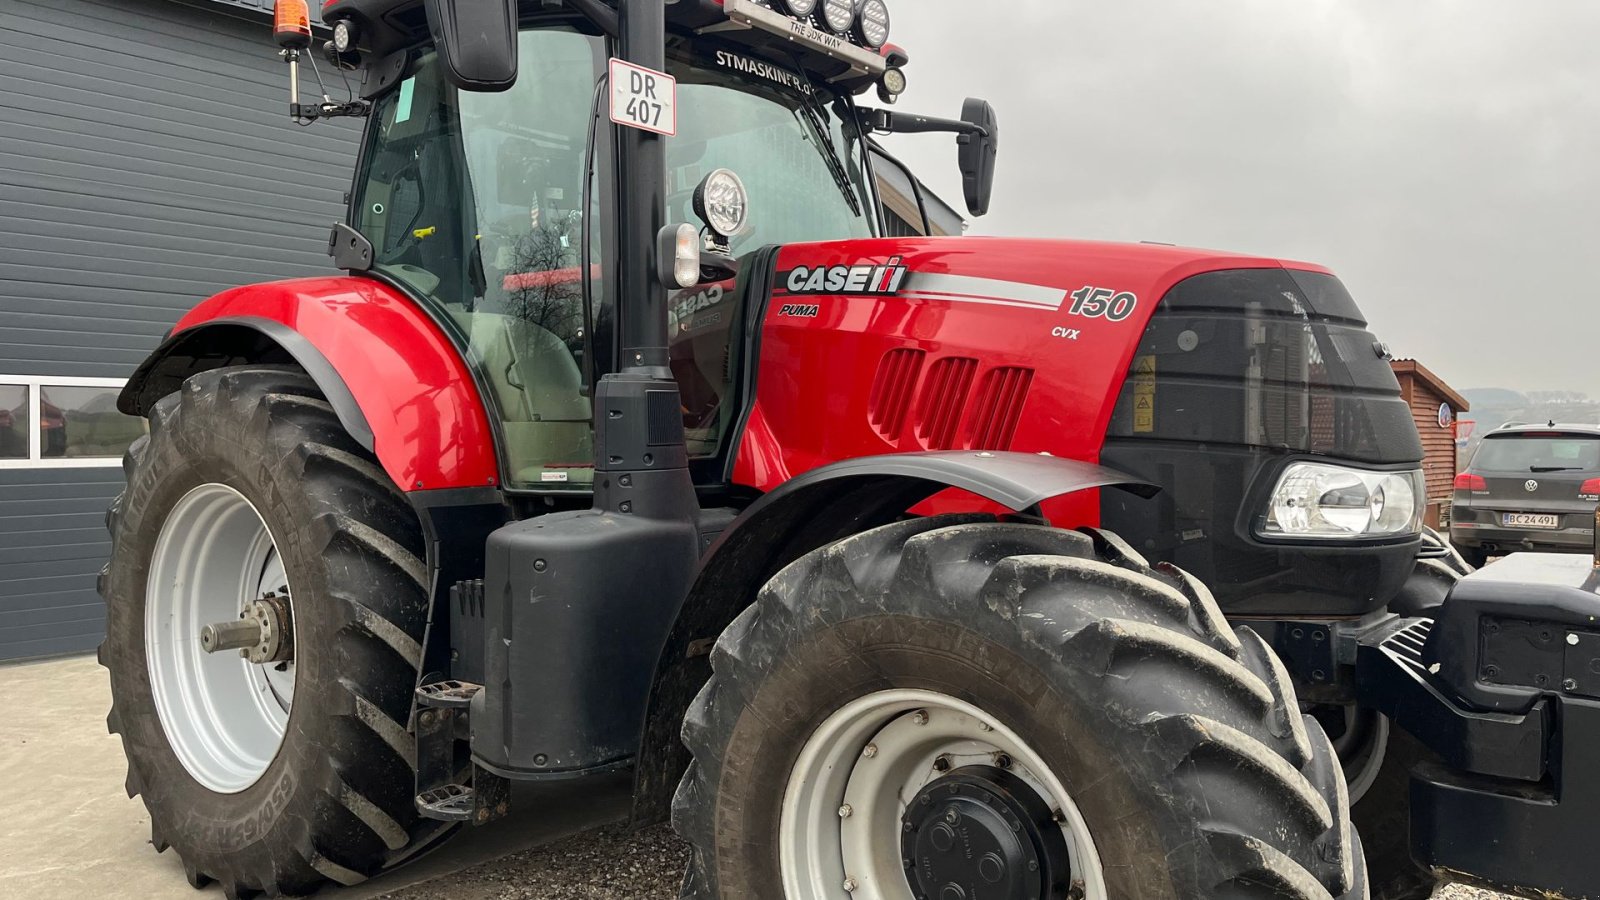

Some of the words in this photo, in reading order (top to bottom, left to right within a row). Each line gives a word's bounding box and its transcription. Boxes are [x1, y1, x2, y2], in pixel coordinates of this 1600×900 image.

[790, 21, 806, 36] THE
[824, 35, 842, 48] WAY
[630, 70, 657, 100] DR
[626, 97, 662, 127] 407
[786, 265, 872, 293] CASE
[778, 304, 820, 318] PUMA
[1068, 285, 1137, 322] 150
[1051, 326, 1080, 340] CVX
[1509, 514, 1523, 523] BC
[1524, 515, 1536, 524] 24
[1538, 516, 1555, 525] 491
